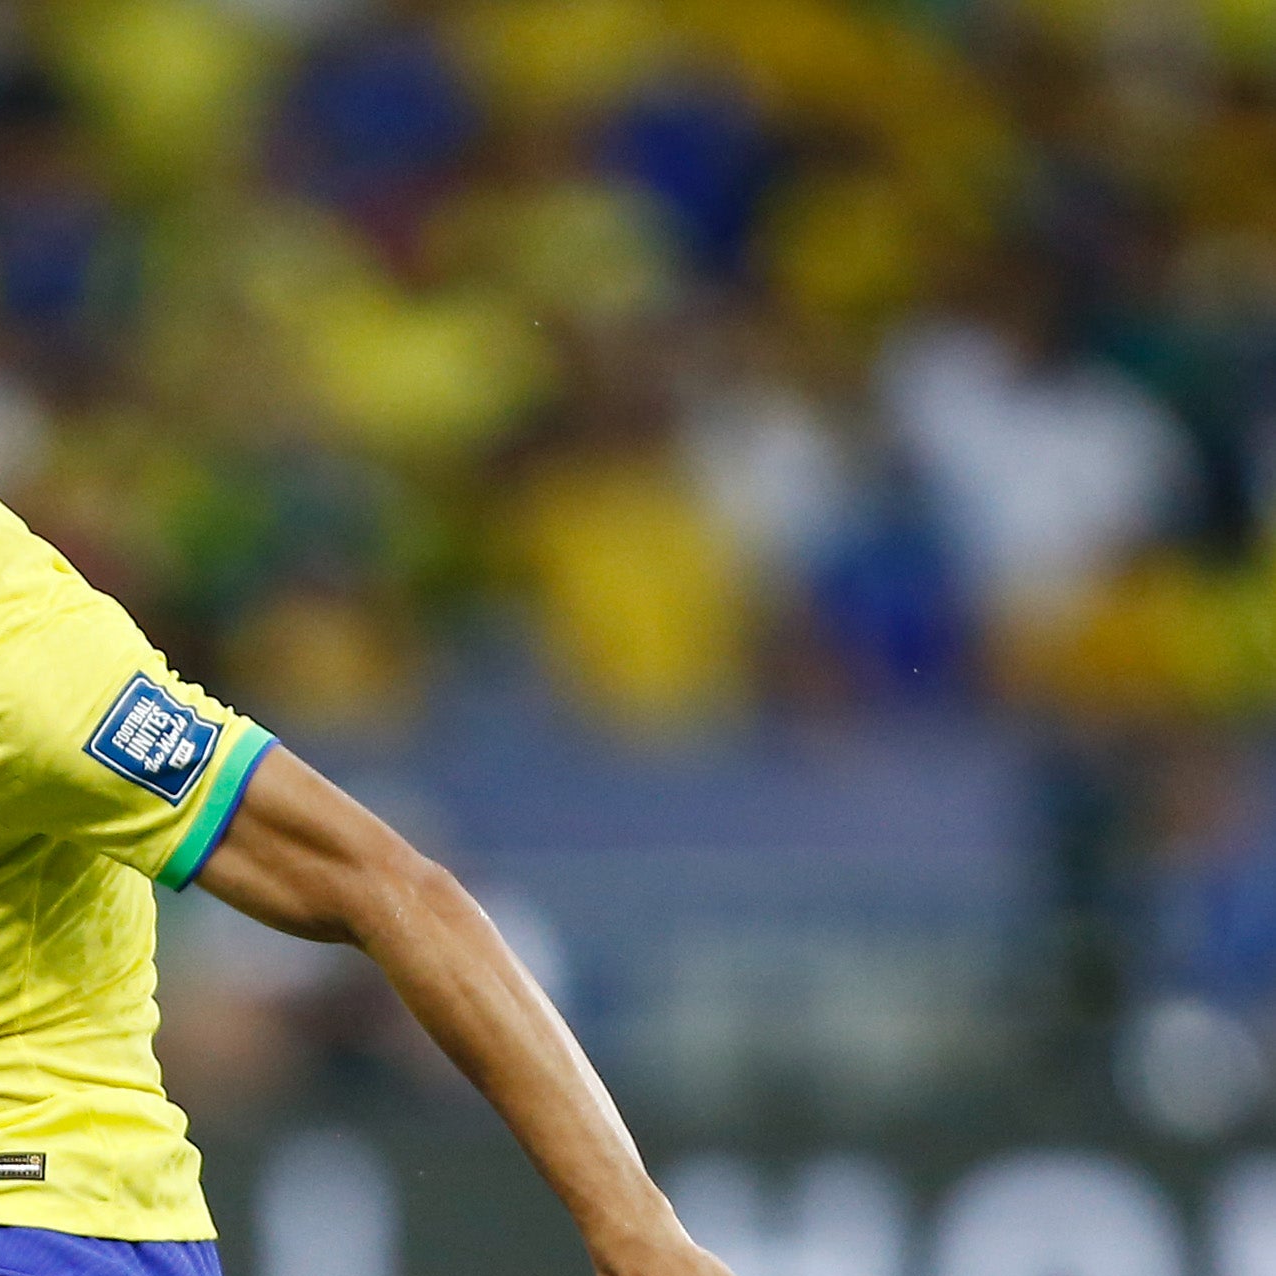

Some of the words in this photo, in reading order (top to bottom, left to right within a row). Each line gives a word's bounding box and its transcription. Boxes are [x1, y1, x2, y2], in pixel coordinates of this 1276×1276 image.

[111, 695, 155, 750] FOOTBALL
[124, 705, 170, 761] UNITES
[143, 752, 165, 773] the
[154, 712, 188, 754] World
